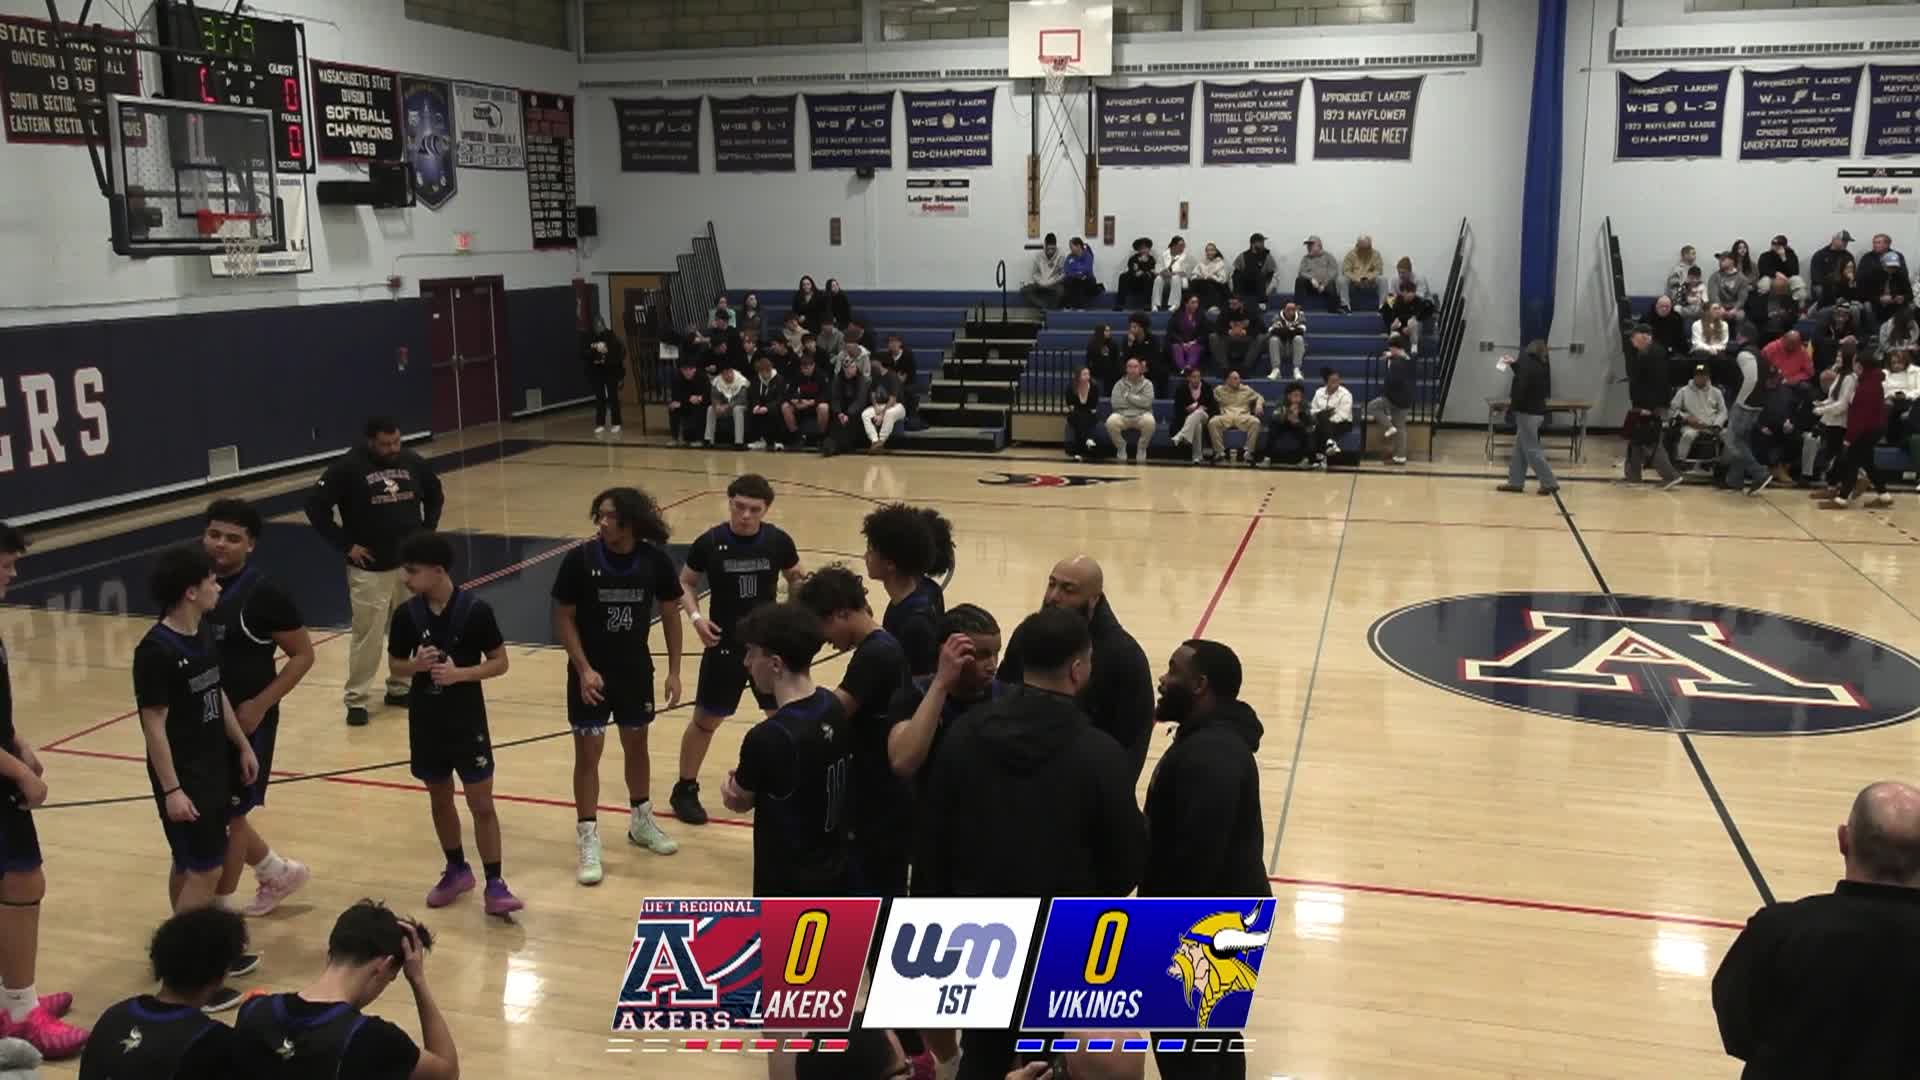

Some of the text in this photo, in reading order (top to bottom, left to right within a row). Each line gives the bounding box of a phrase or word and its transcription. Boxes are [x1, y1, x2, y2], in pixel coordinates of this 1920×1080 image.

[0, 23, 48, 47] STATE
[11, 50, 56, 68] DIVISION
[268, 63, 293, 75] GUEST
[319, 69, 391, 91] MASSACHUSETTS STATE
[1684, 83, 1718, 92] LAKERS
[9, 92, 39, 110] SOUTH
[1322, 90, 1411, 102] APPONEQUET LAKERS
[326, 105, 391, 124] SOFTBALL
[1323, 108, 1406, 120] 1973 MAYFLOWER
[9, 115, 51, 132] EASTERN
[1756, 126, 1837, 136] CROSS COUNTRY
[326, 123, 393, 140] CHAMPIONS
[1319, 127, 1408, 144] ALL LEAGUE MEET
[1631, 133, 1709, 144] CHAMPIONS
[1743, 137, 1849, 150] UNDEFEATED CHAMPIONS
[912, 148, 987, 159] CO-CHAMPIONS
[1844, 185, 1913, 196] Visiting Fan
[1855, 196, 1898, 205] Section
[607, 606, 633, 632] 24
[1457, 608, 1870, 709] A
